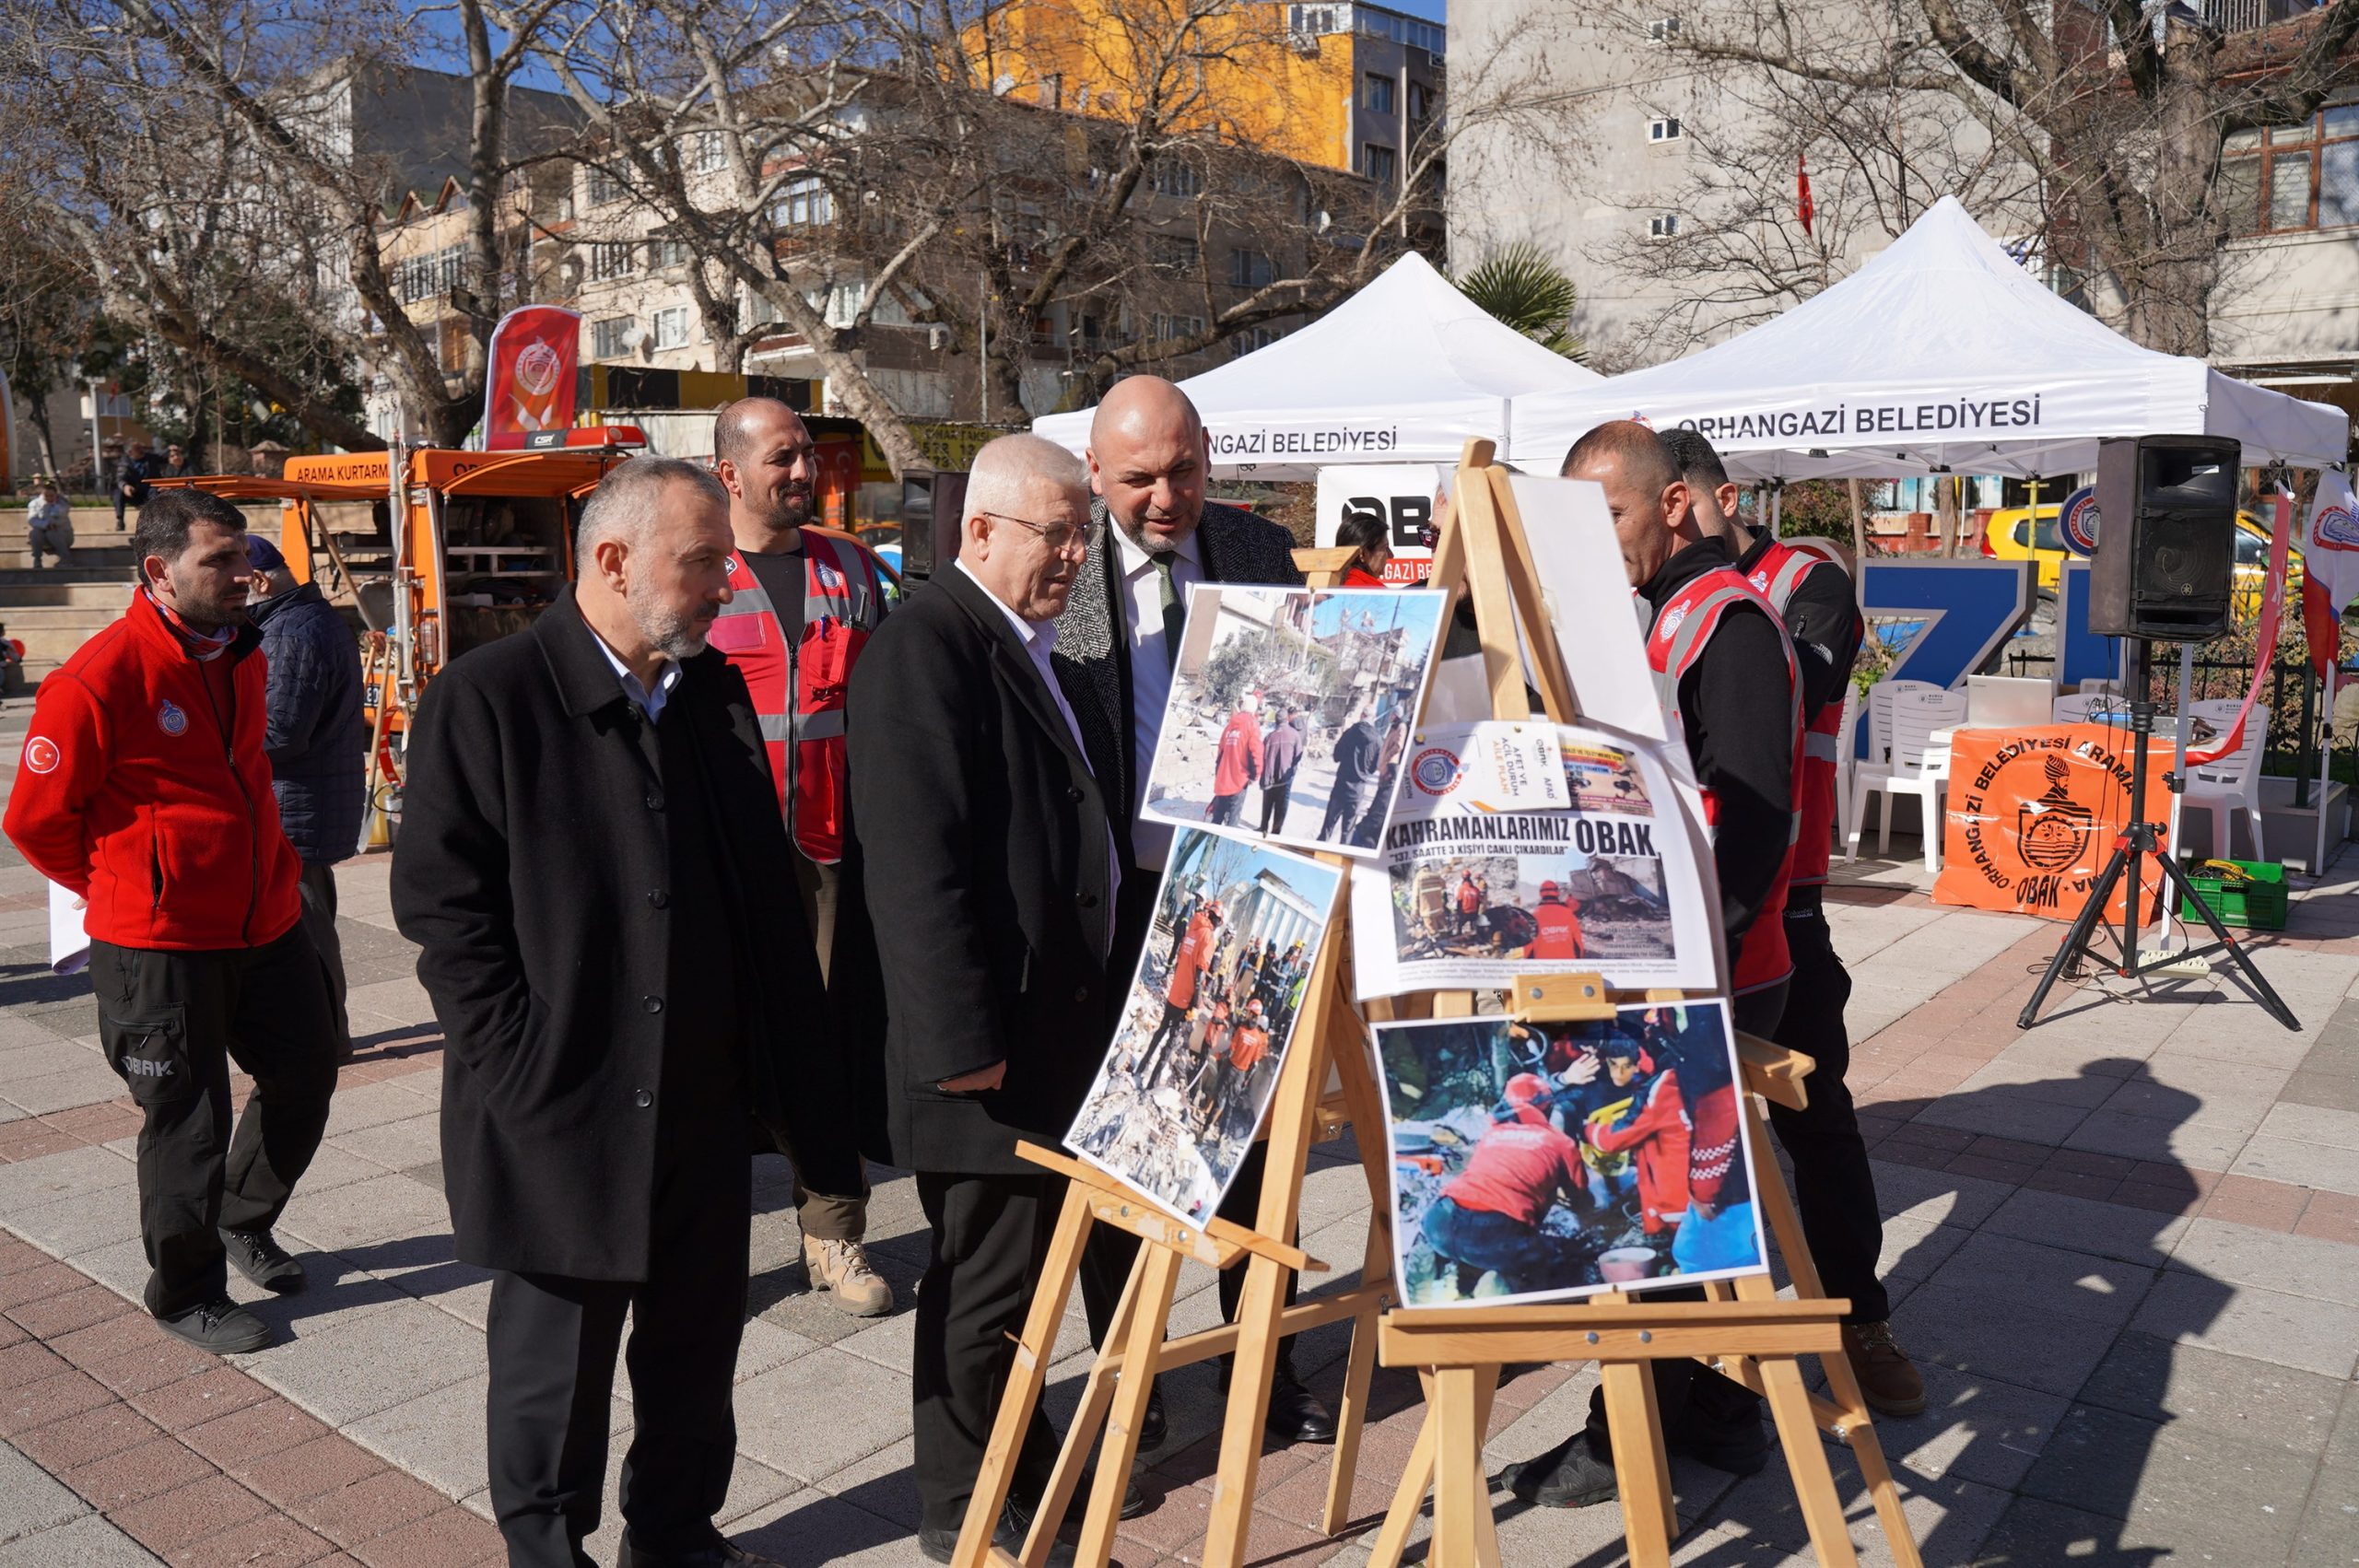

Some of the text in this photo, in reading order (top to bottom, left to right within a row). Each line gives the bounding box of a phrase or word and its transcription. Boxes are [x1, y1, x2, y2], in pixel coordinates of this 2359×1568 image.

[1677, 393, 2040, 439] ORHANGAZİ BELEDİYESİ
[1208, 426, 1397, 454] NGAZİ BELEDİYESİ
[297, 463, 390, 482] ARAMA KURTARM
[1383, 560, 1414, 580] GAZİ
[1506, 761, 1520, 797] DURUM
[1513, 746, 1528, 786] AFET VE
[1974, 734, 2071, 792] BELEDİYESİ
[1386, 816, 1657, 858] KAHRAMANLARIMIZ OBAK
[1412, 847, 1448, 860] SAATTE
[1448, 846, 1456, 856] 3
[1486, 845, 1513, 856] CANLI
[1965, 793, 2011, 890] ORHANGAZİ
[2015, 874, 2060, 908] OBAK
